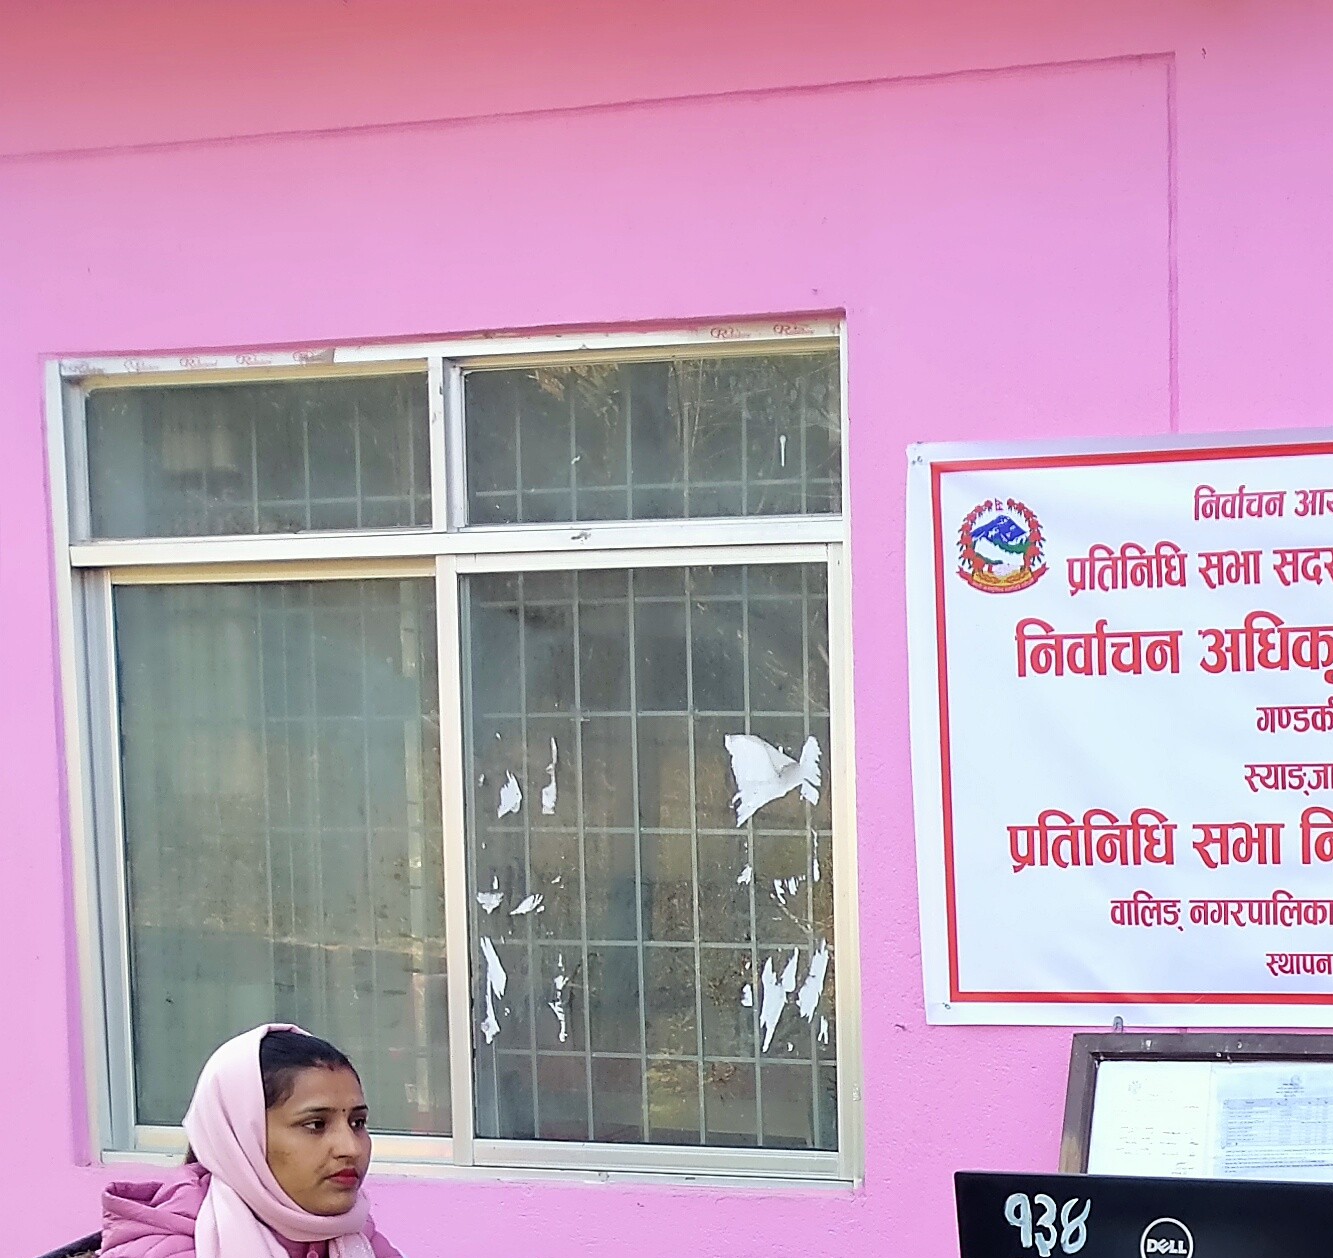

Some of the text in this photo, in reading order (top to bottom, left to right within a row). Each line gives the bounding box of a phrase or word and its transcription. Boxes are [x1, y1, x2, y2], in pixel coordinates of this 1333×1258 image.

[1193, 485, 1286, 521] निर्वाचन
[1067, 541, 1188, 597] प्रतिनिधि
[1197, 549, 1263, 590] सभा
[1015, 617, 1183, 679] निर्वाचन
[1007, 807, 1178, 874] प्रतिनिधि
[1191, 821, 1286, 870] सभा
[1110, 889, 1184, 931] वालिङ्
[1146, 1238, 1188, 1255] DELL
